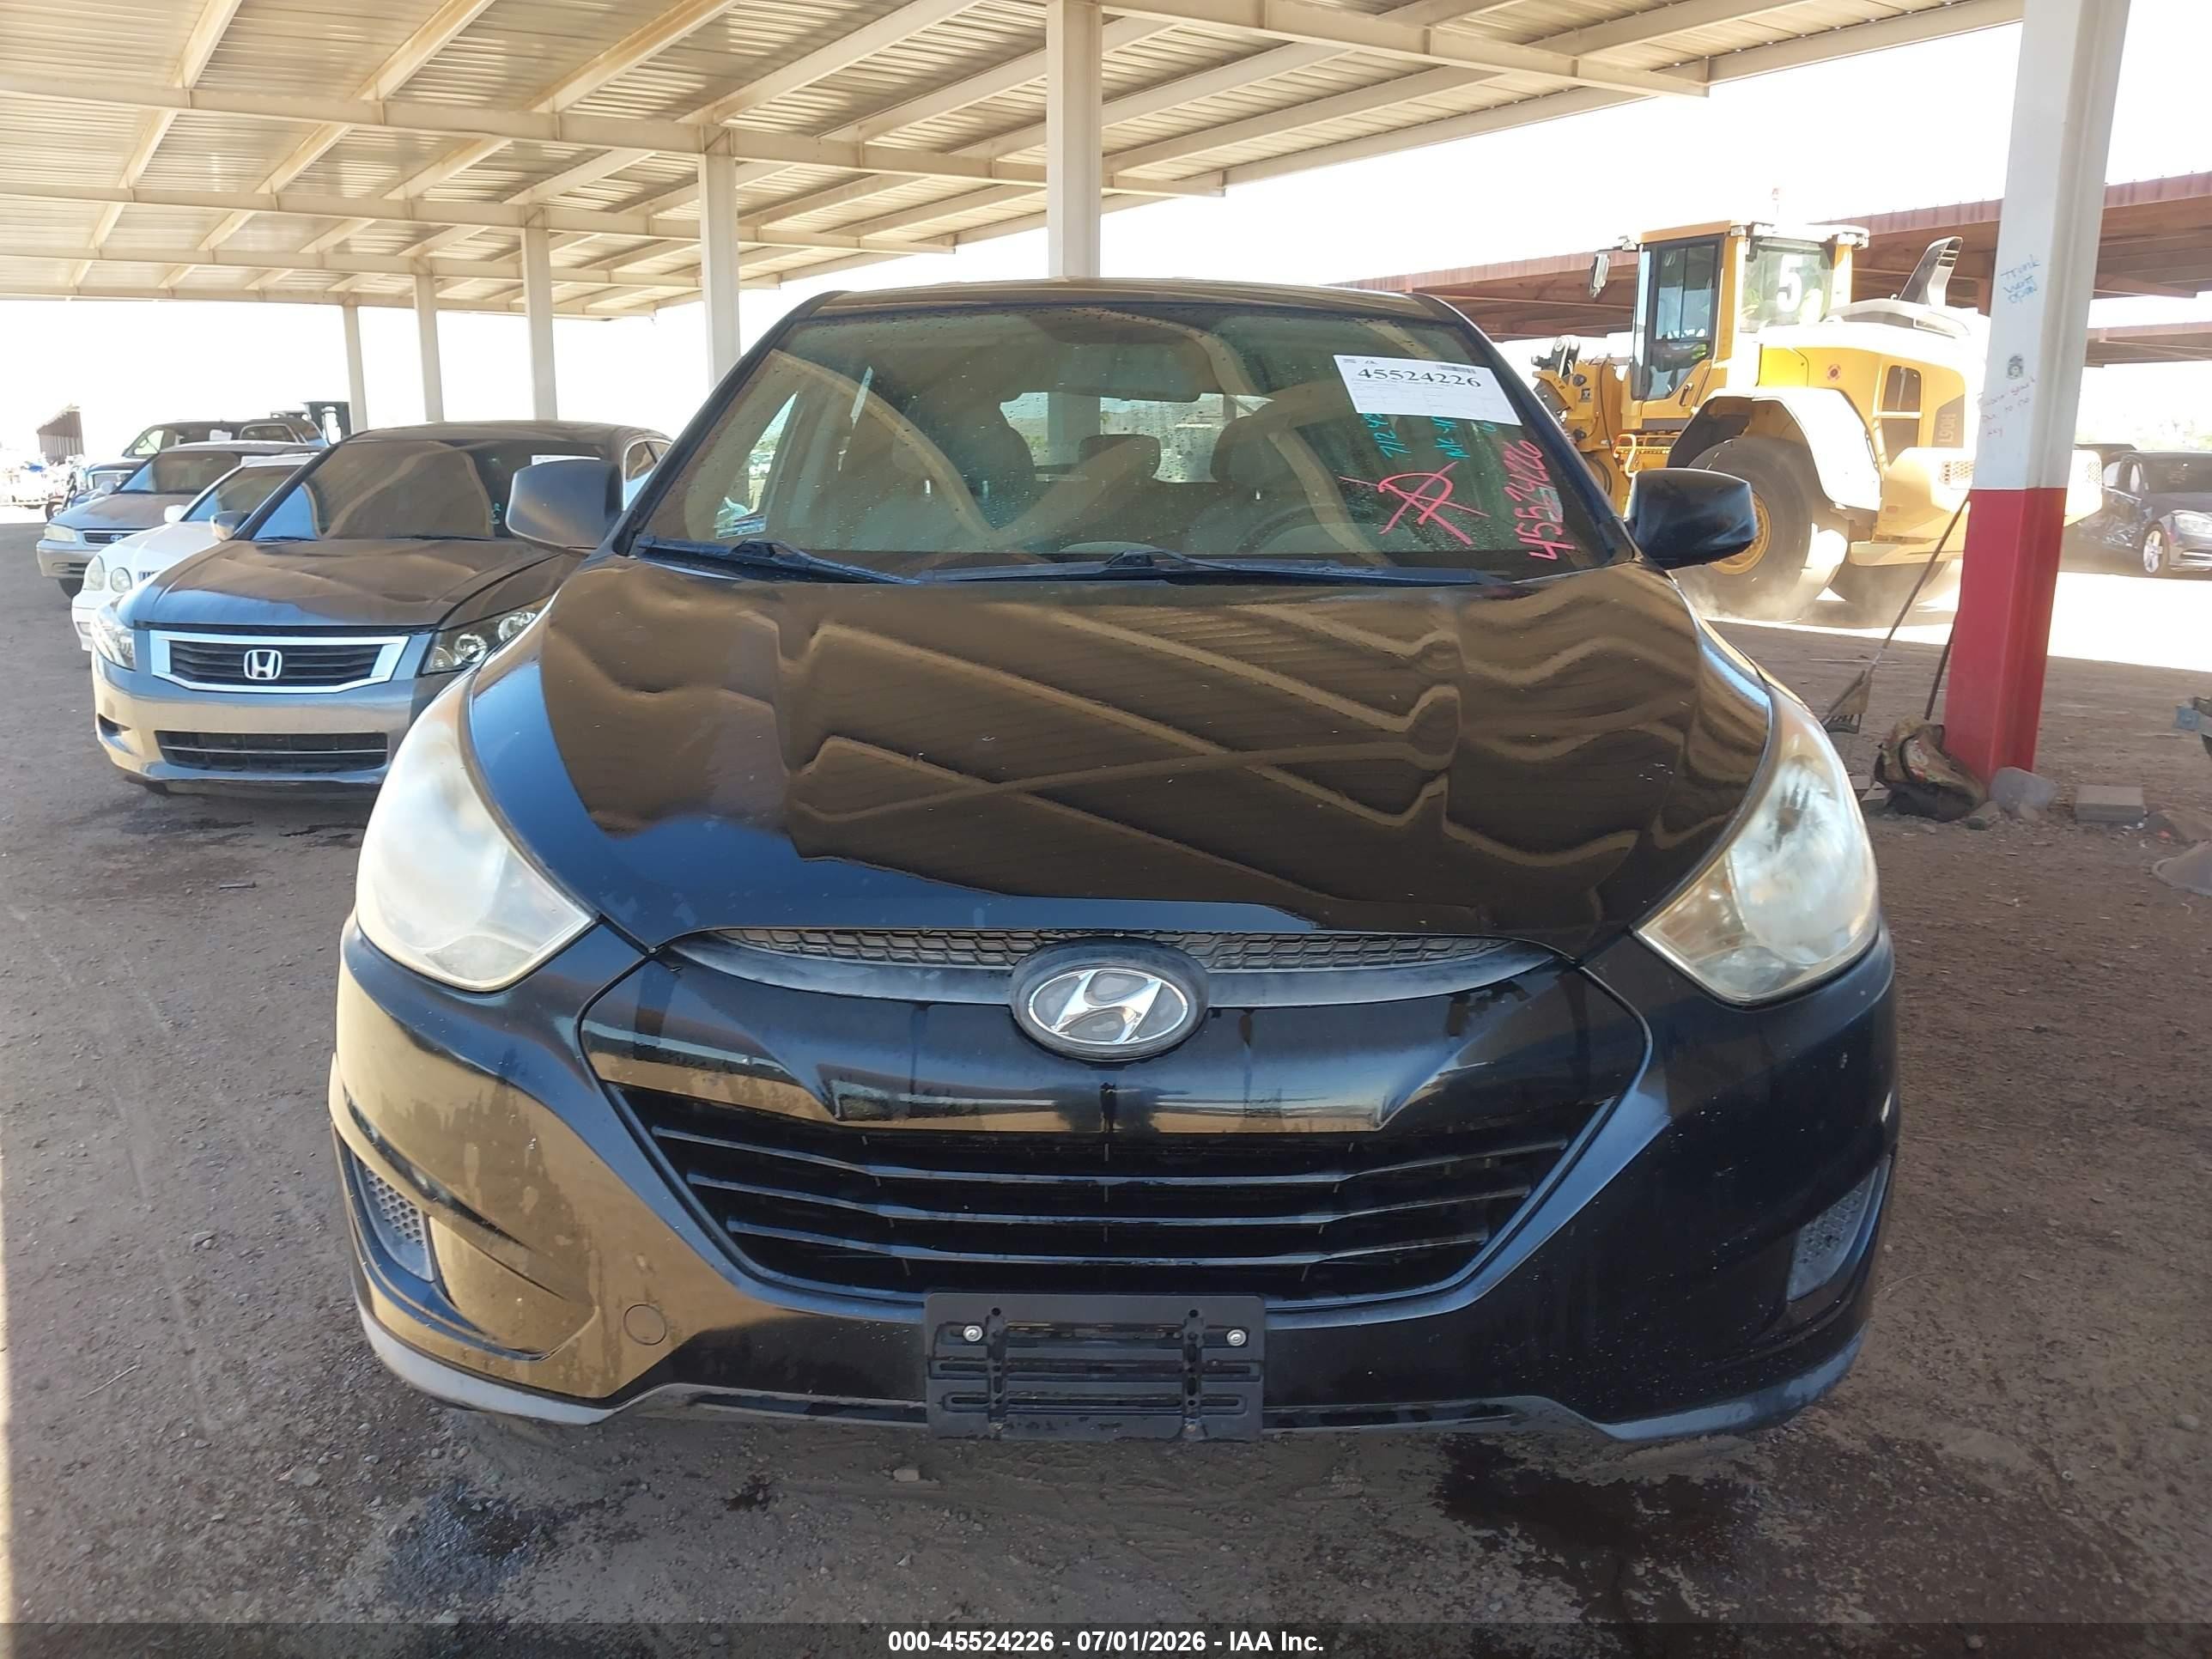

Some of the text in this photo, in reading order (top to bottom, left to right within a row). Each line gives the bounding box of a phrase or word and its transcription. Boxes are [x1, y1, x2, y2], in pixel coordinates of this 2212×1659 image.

[1777, 253, 1802, 313] 5
[1358, 368, 1482, 388] 45524226
[1504, 439, 1575, 560] 45524226
